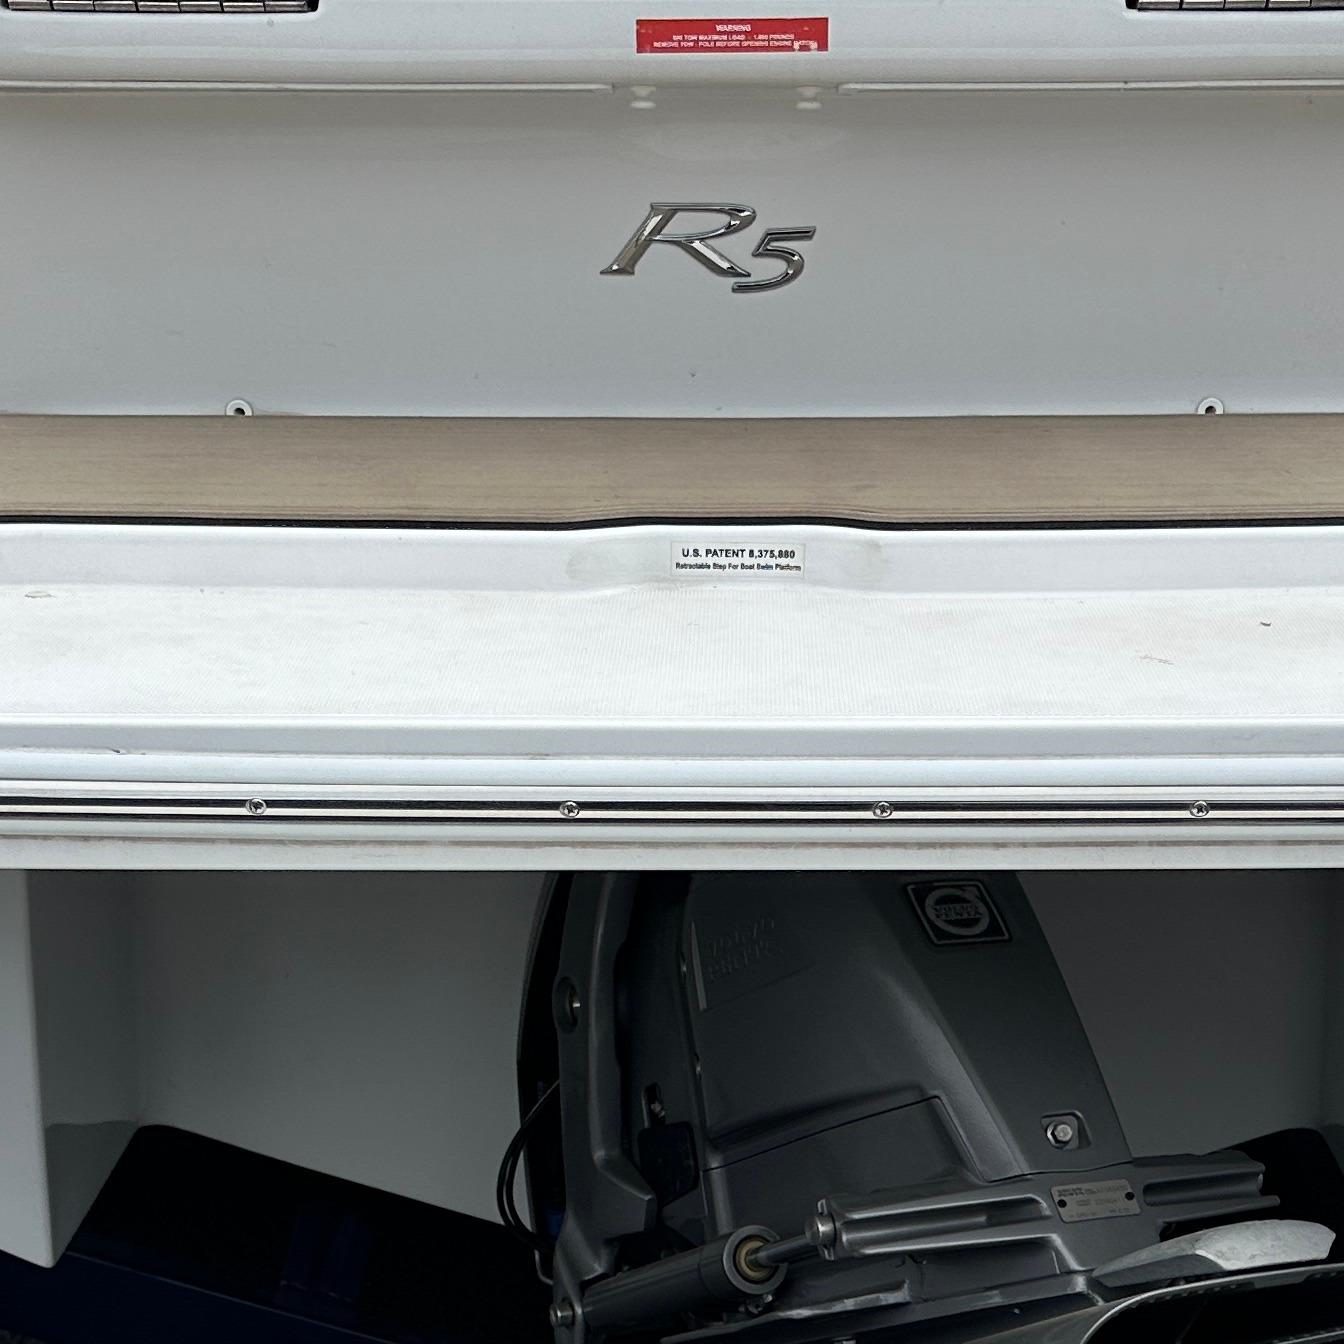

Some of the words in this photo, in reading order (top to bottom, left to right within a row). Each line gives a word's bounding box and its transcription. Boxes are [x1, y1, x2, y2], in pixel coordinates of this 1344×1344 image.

[599, 202, 817, 293] R5
[682, 548, 702, 558] U.S.
[706, 549, 746, 558] PATENT
[676, 562, 711, 570] Retractable
[712, 563, 726, 571] Step
